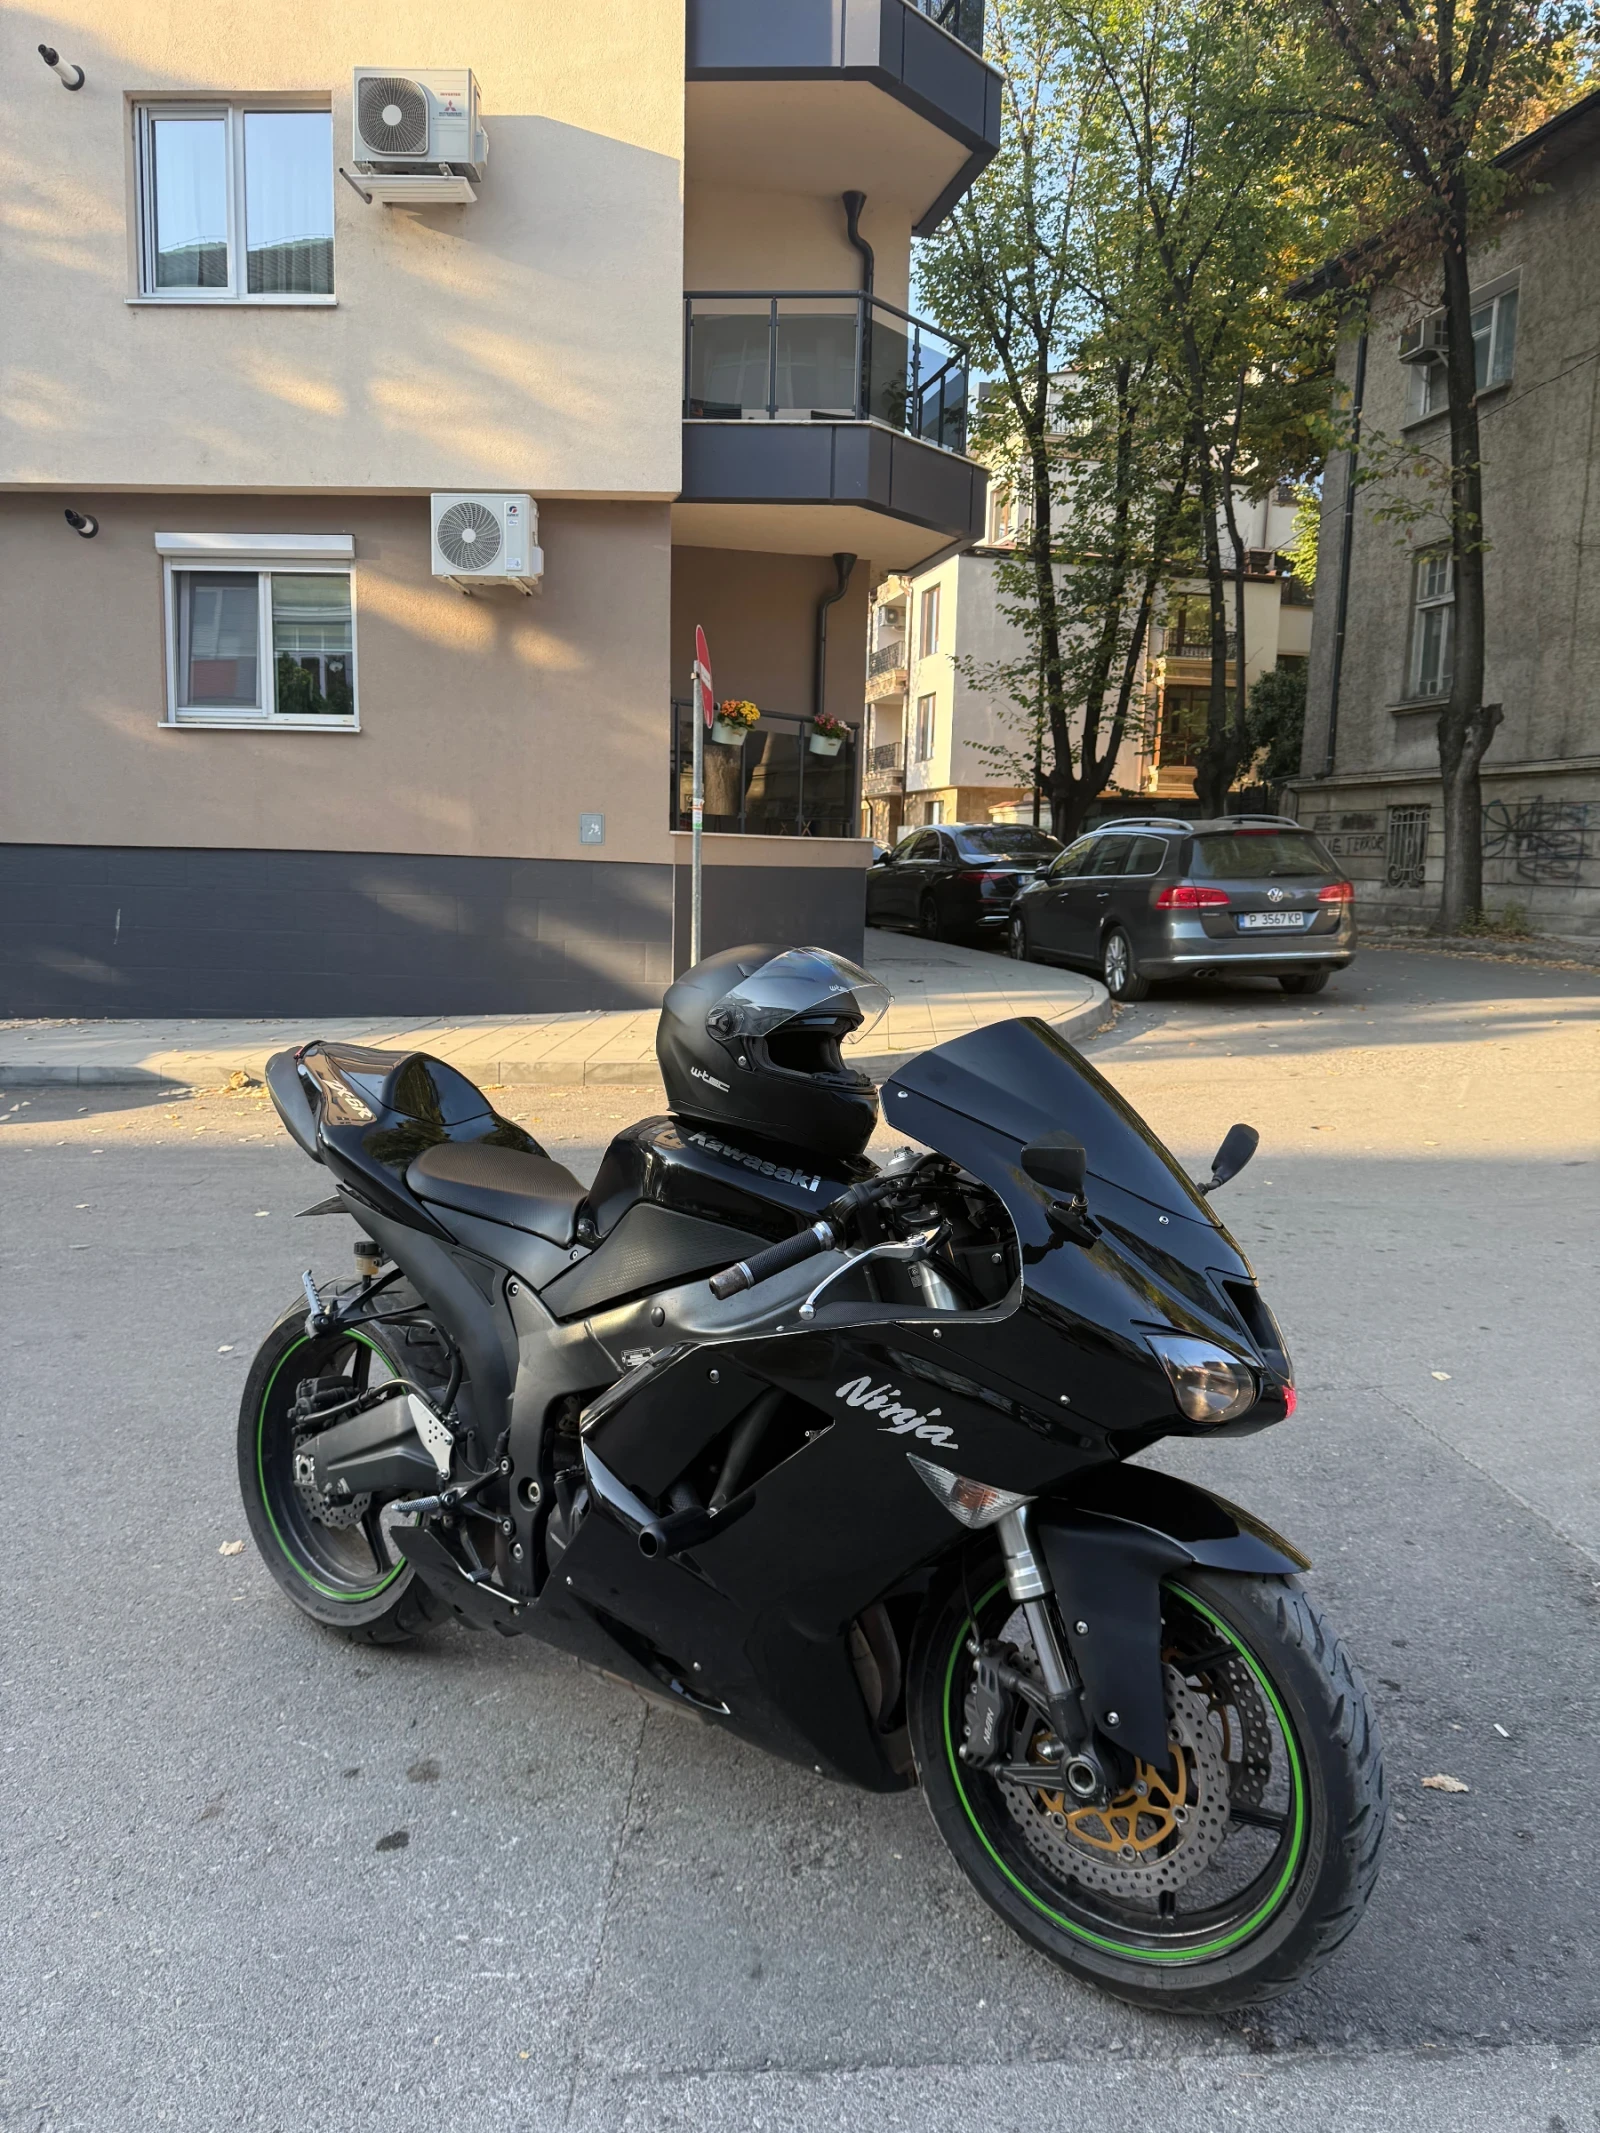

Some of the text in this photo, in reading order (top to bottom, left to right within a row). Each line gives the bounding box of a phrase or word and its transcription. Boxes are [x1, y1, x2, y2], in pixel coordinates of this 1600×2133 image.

[1249, 912, 1302, 925] P 3567 KP
[688, 1131, 822, 1192] Kawasaki
[835, 1375, 959, 1450] Ninja
